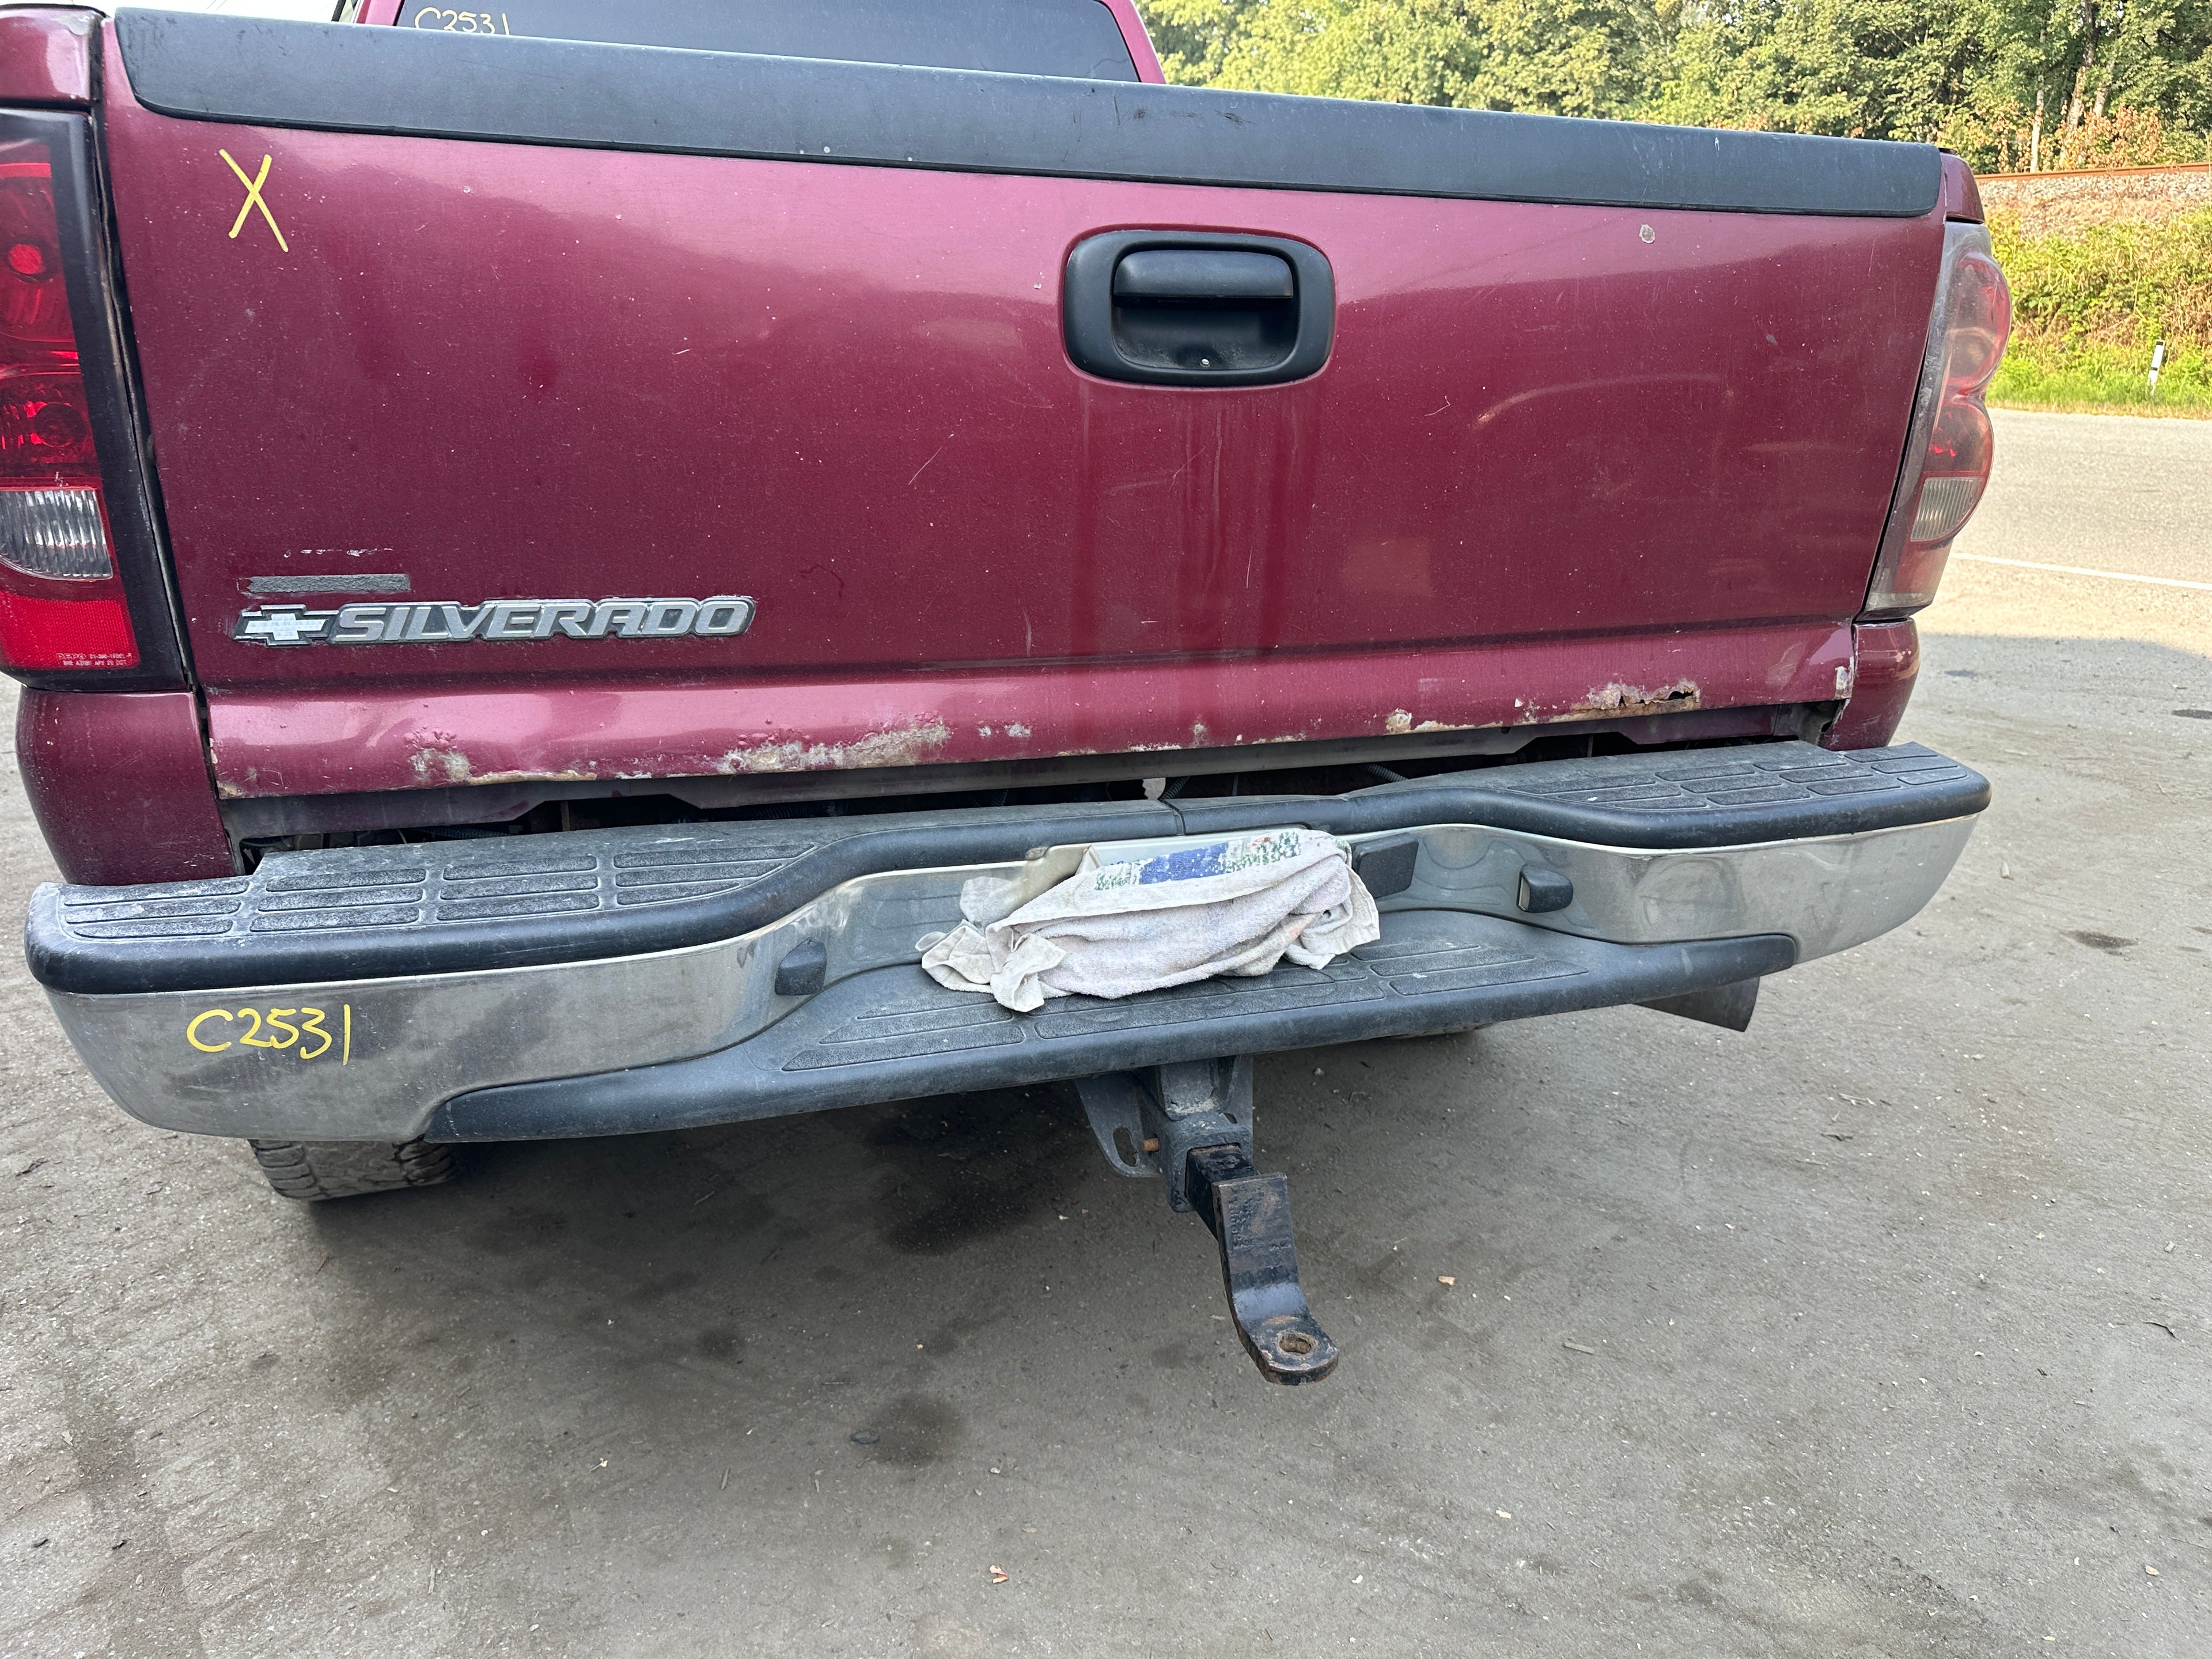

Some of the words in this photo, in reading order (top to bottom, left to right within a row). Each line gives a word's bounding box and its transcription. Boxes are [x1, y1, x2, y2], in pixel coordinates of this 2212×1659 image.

[414, 6, 510, 36] C2531
[218, 148, 289, 252] X
[332, 597, 755, 643] SILVERADO
[186, 1003, 351, 1066] C2531
